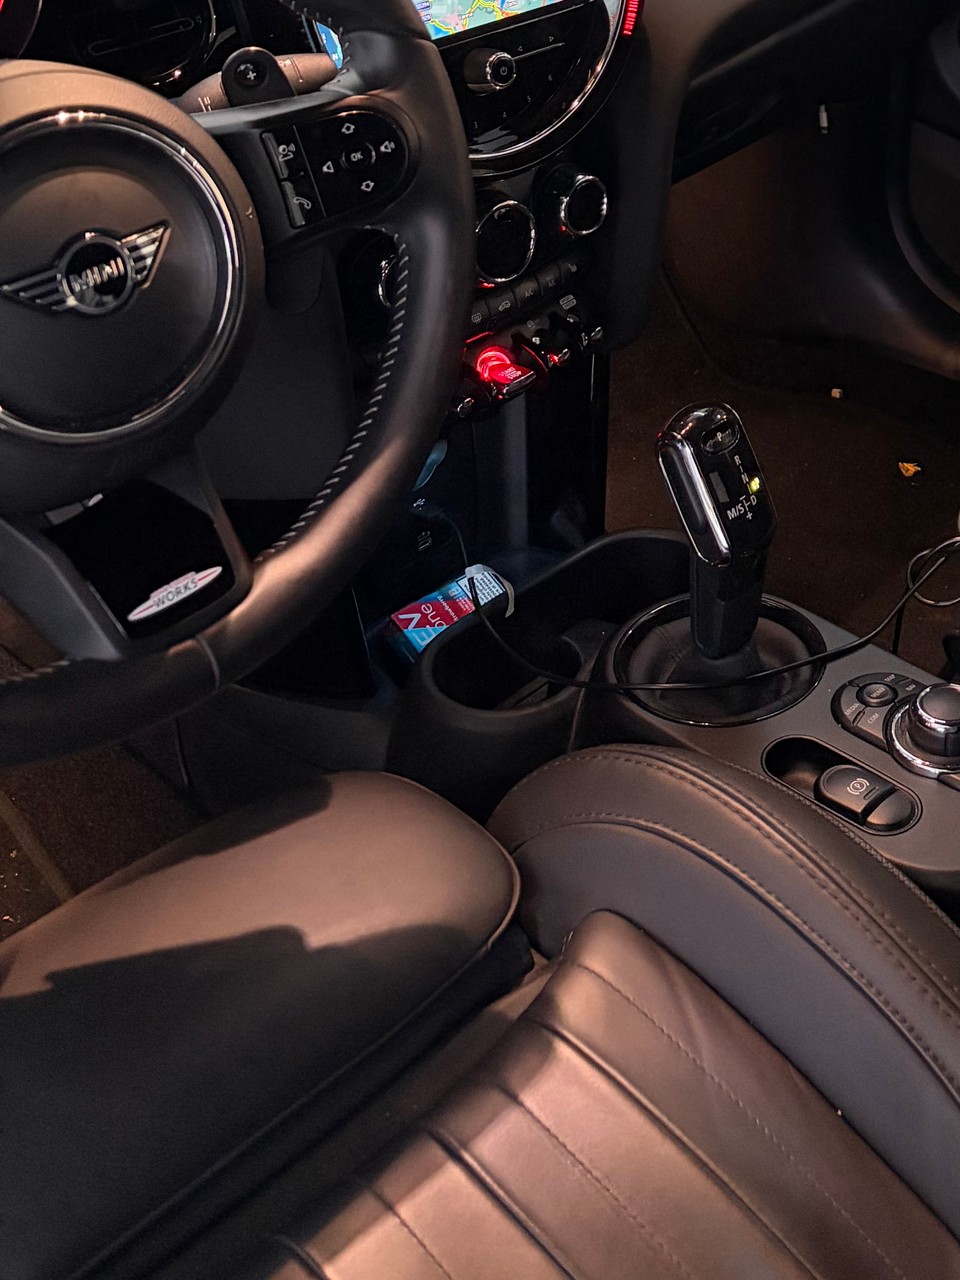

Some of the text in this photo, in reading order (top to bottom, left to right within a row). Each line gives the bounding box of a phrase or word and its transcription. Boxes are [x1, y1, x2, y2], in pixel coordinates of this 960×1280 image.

[350, 151, 364, 162] OK
[68, 256, 126, 293] MINI
[734, 455, 742, 466] R
[741, 472, 749, 484] N
[750, 495, 757, 506] D
[153, 577, 199, 608] WORKS
[870, 686, 886, 698] MENU
[843, 702, 860, 716] MEDIA
[867, 712, 880, 724] COM
